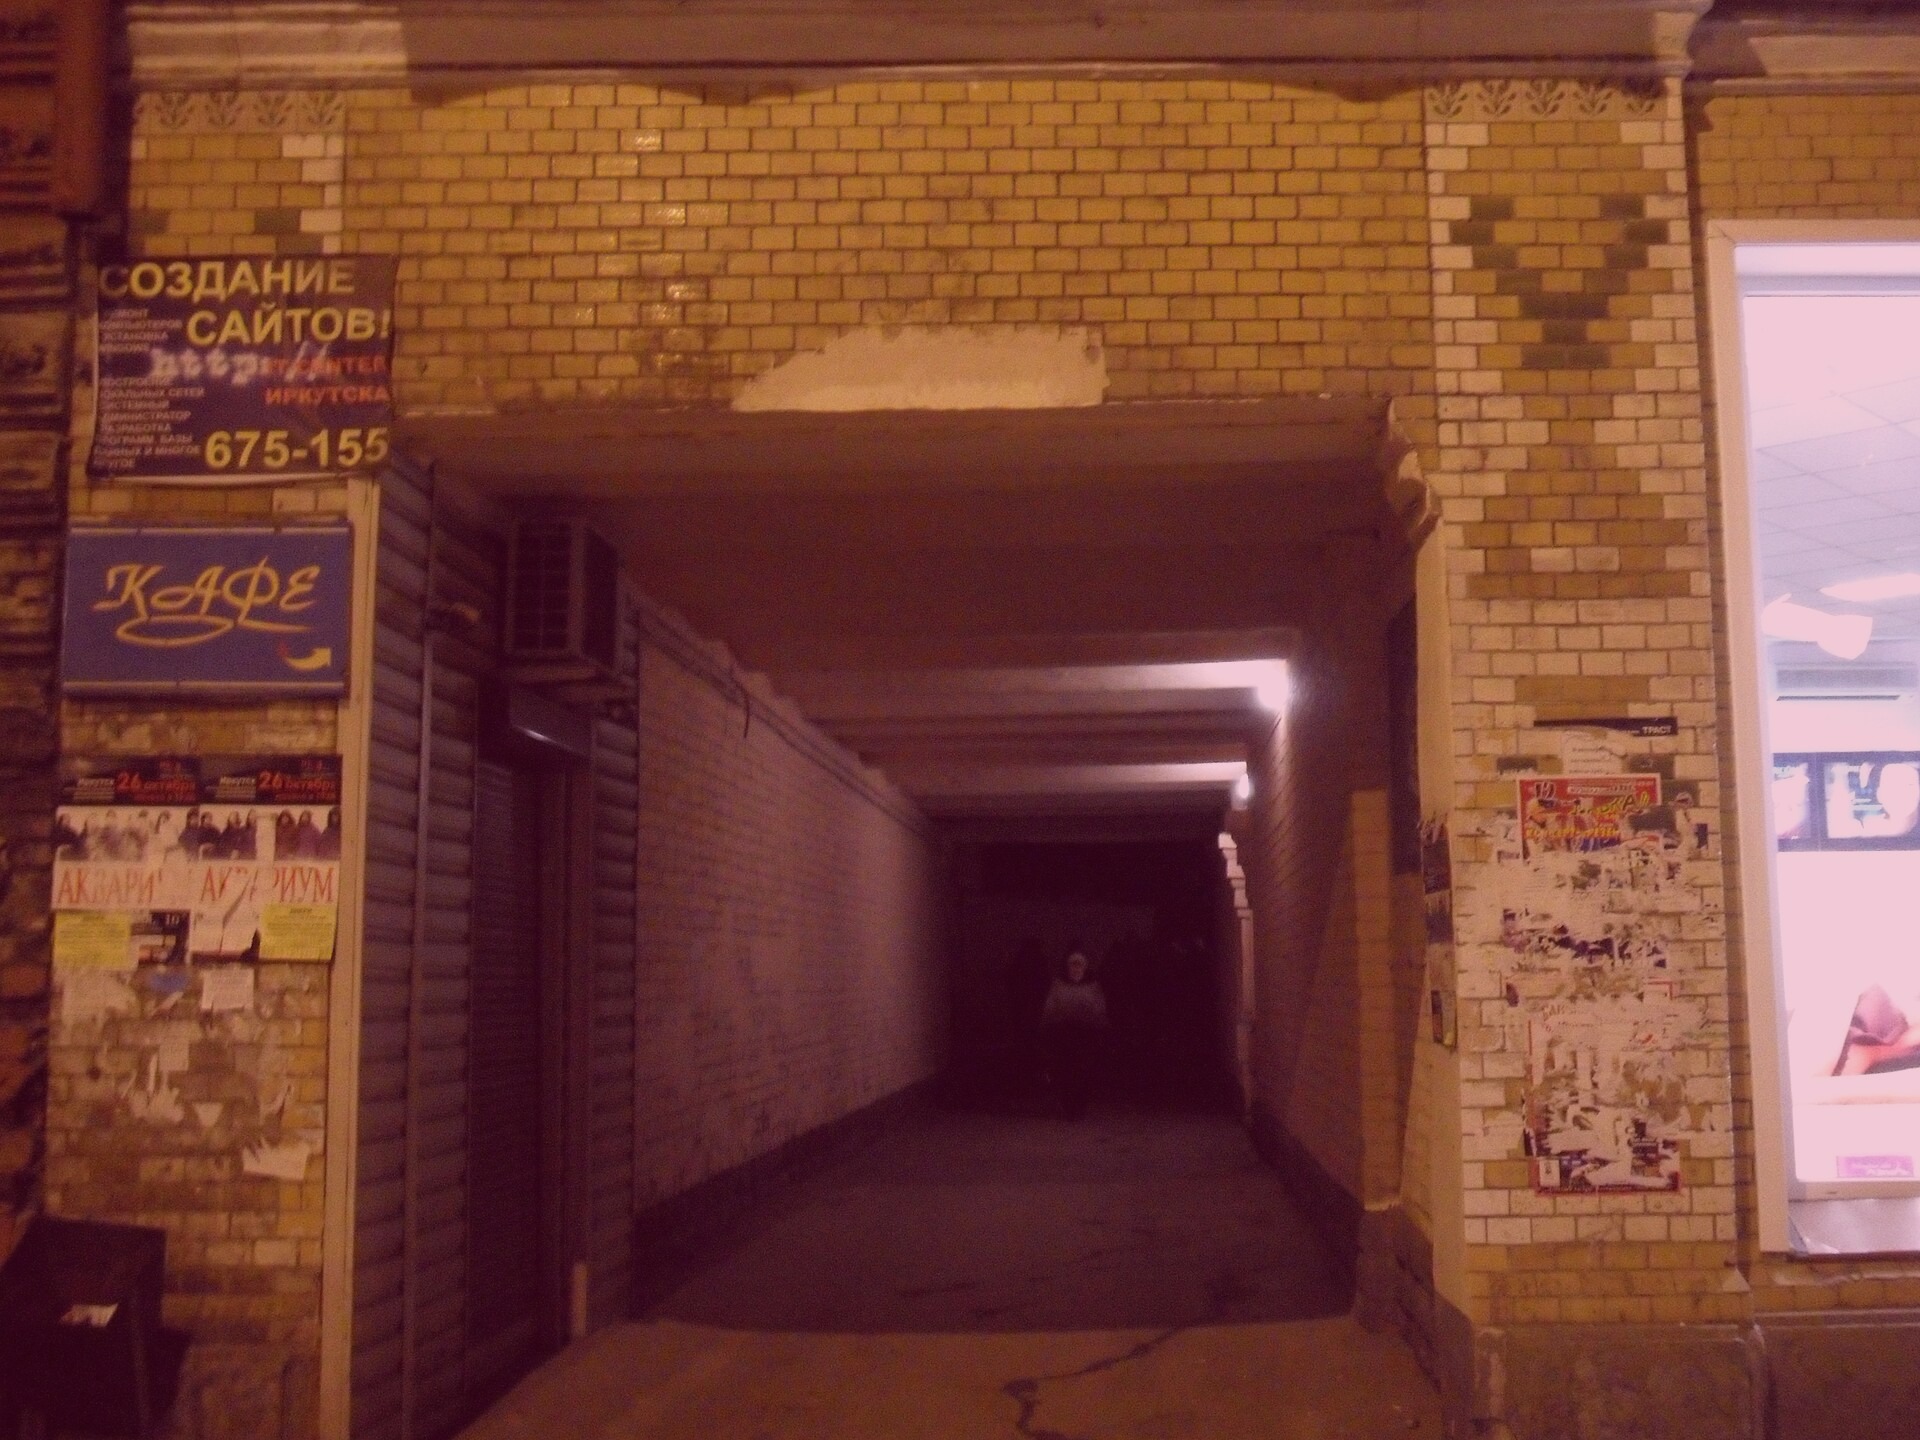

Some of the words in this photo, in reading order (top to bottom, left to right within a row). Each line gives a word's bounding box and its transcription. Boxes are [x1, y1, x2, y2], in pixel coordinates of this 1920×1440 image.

[101, 260, 356, 303] СОЗДАНИЕ
[186, 302, 391, 345] САЙТОВ!
[265, 385, 390, 405] ИРКУТСКА
[205, 428, 388, 468] 675-155
[92, 556, 320, 632] КАФЕ
[258, 770, 283, 790] 26
